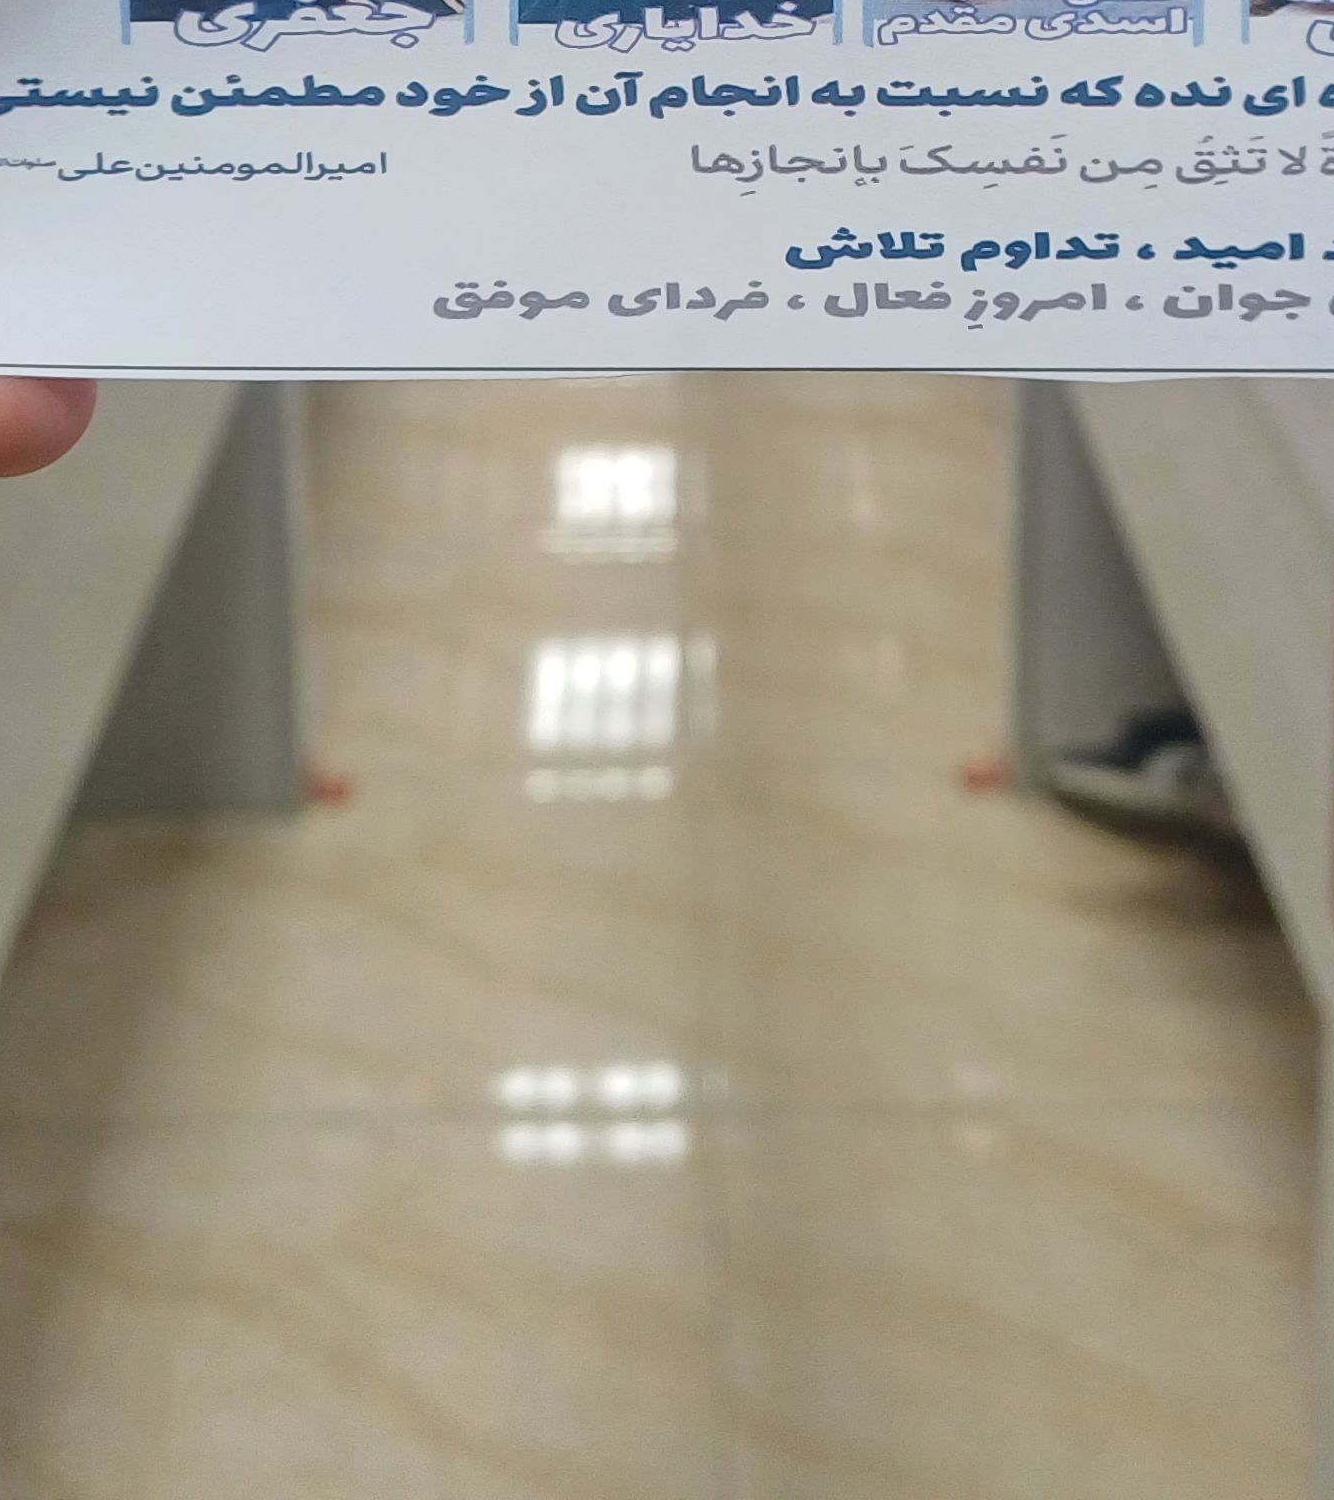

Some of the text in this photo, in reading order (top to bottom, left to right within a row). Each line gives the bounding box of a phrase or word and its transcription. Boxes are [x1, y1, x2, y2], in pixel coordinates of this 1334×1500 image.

[555, 0, 818, 53] خدایاری
[877, 5, 1188, 46] اسدی مقدم
[170, 73, 387, 118] مطمئن
[395, 74, 512, 118] خود
[513, 74, 565, 118] از
[575, 70, 645, 117] آن
[648, 74, 801, 120] انجام
[810, 79, 866, 118] به
[876, 75, 1050, 118] نسبت
[1059, 74, 1125, 108] که
[1133, 75, 1233, 109] نده
[1242, 75, 1307, 118] ای
[1277, 145, 1307, 176] لا
[784, 226, 946, 271] تلاش
[960, 231, 1121, 273] تداوم
[1172, 232, 1306, 271] امید
[432, 279, 591, 321] موفق
[607, 279, 770, 322] فردای
[823, 280, 952, 319] فعال
[1162, 283, 1312, 323] جوان
